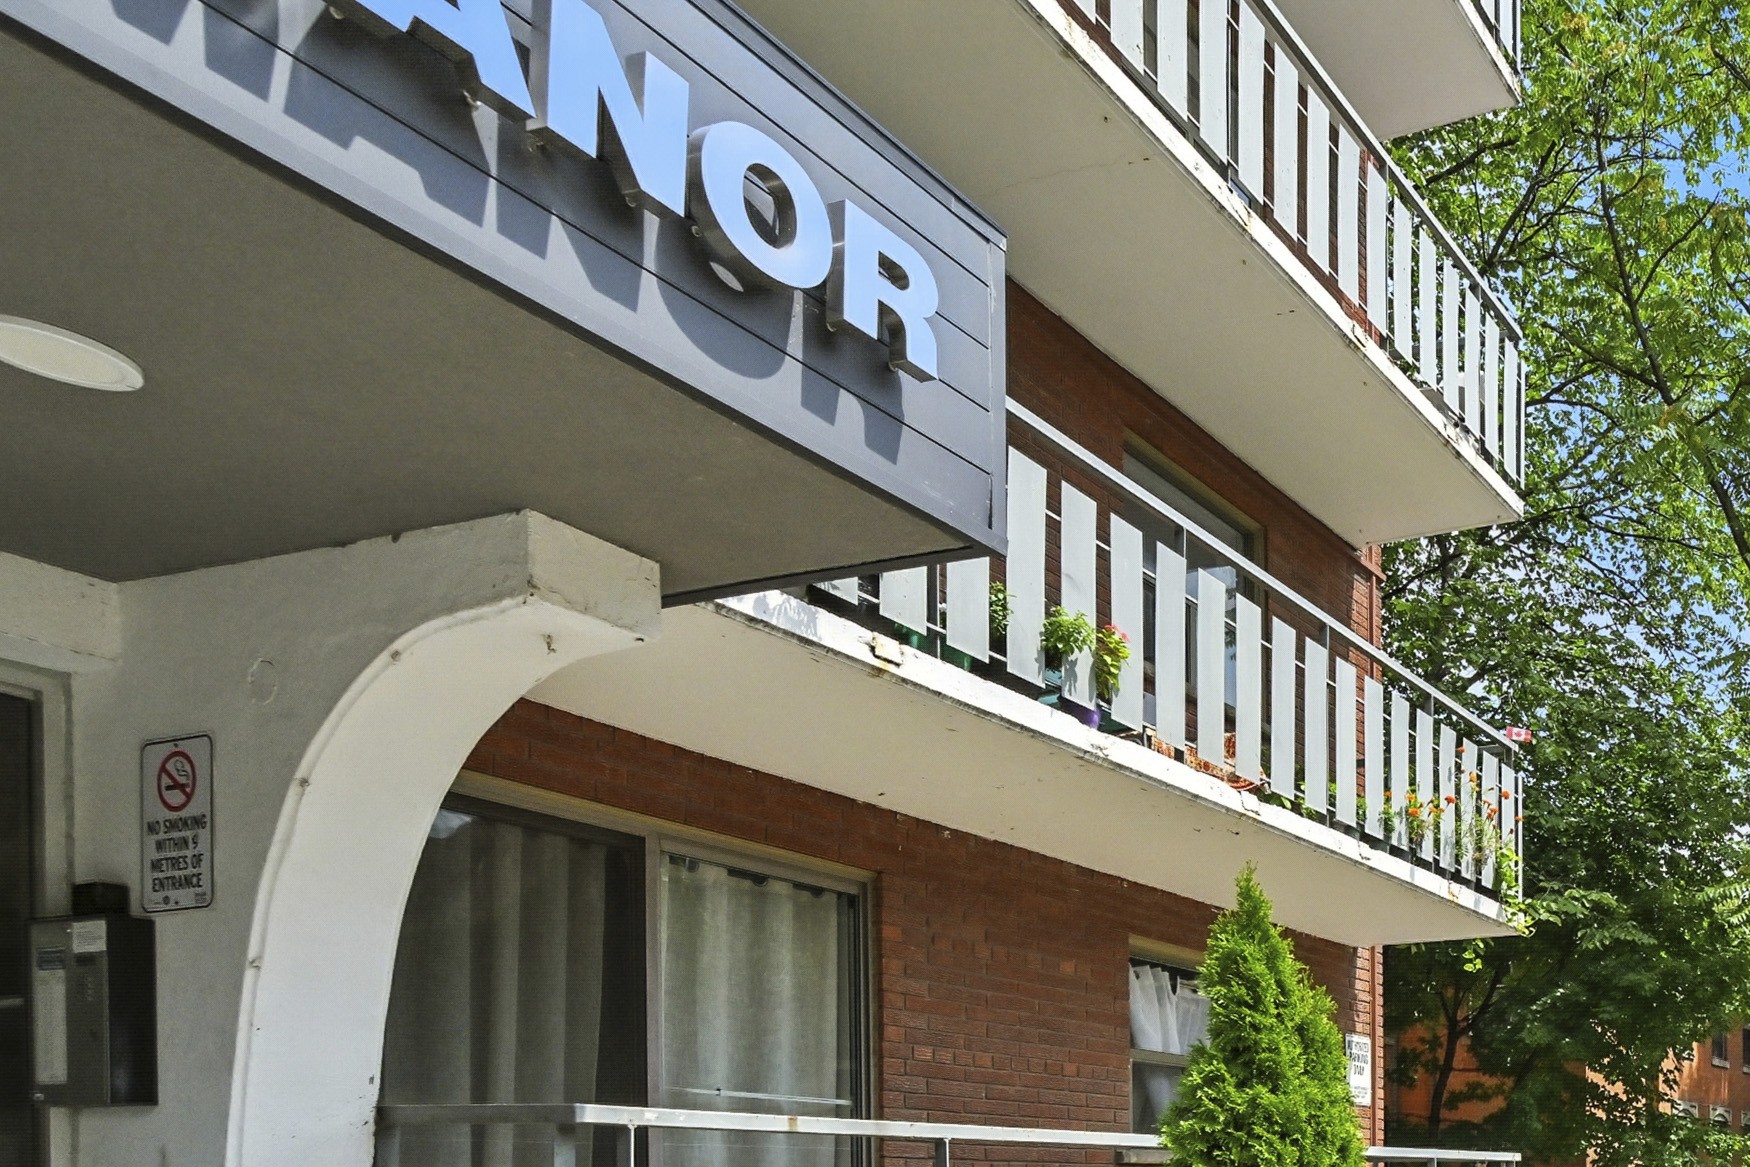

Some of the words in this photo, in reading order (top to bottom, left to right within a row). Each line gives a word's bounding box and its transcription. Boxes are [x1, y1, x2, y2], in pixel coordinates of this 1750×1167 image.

[147, 820, 161, 835] NO
[163, 813, 207, 834] SMOKING
[155, 837, 189, 854] WITHIN
[150, 855, 188, 873] METRES
[190, 853, 204, 869] OF
[152, 872, 203, 893] ENTRANCE
